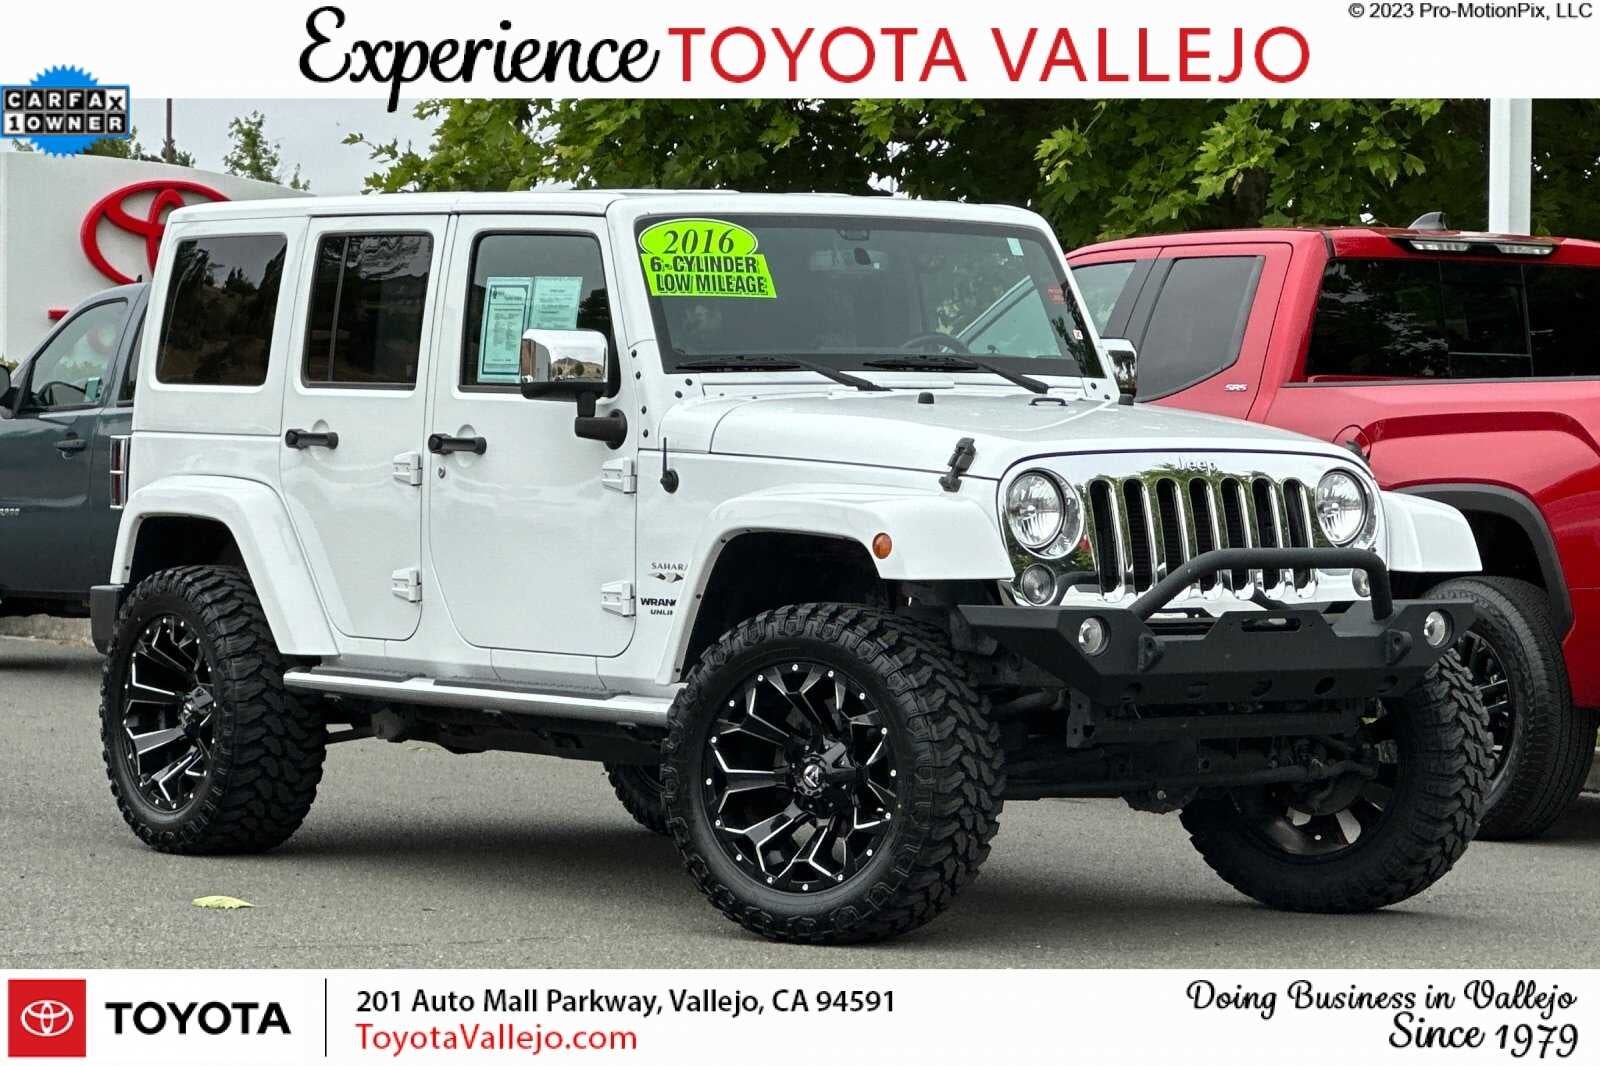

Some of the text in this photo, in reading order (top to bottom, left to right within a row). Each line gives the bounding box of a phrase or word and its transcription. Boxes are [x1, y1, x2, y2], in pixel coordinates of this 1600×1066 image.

[663, 228, 735, 255] 2016
[650, 255, 758, 273] 6-CYLINDER
[656, 274, 768, 295] LOW MILEAGE
[1178, 456, 1217, 476] Jeep
